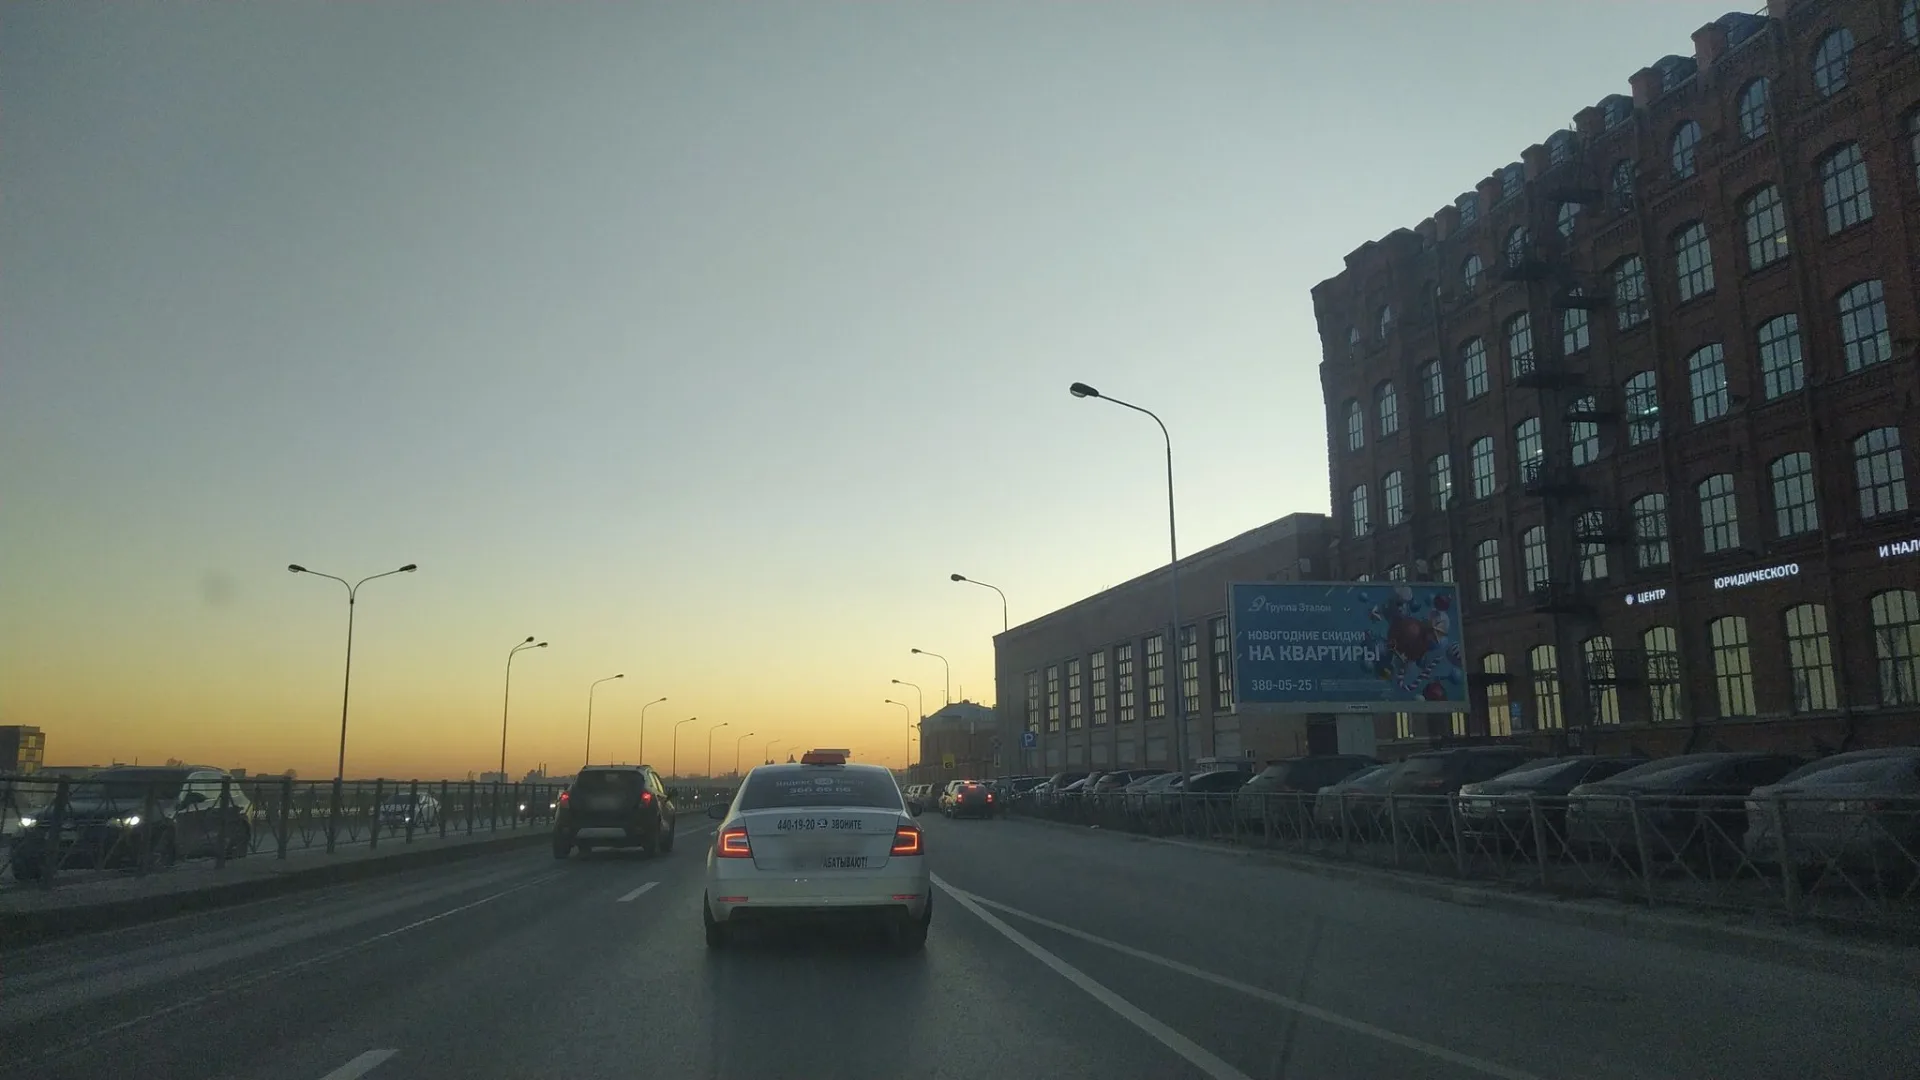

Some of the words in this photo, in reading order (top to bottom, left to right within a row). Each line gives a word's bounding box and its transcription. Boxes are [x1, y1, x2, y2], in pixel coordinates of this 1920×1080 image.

[1879, 544, 1889, 558] И
[1714, 563, 1799, 589] ЮРИДИЧЕСКОГО
[1637, 588, 1666, 604] ЦЕНТР
[1265, 602, 1297, 613] Группа
[1298, 602, 1332, 612] Эталон
[1248, 630, 1319, 642] НОВОГОДНИЕ
[1322, 631, 1365, 642] СКИДКИ
[1249, 645, 1275, 661] НА
[1280, 645, 1380, 661] КВАРТИРЫ
[1251, 679, 1312, 691] 380-05-25
[777, 819, 815, 831] 440-19-20
[831, 819, 862, 830] ЗВОНИТЕ
[822, 856, 868, 868] АБАТЫВАЮТ!
